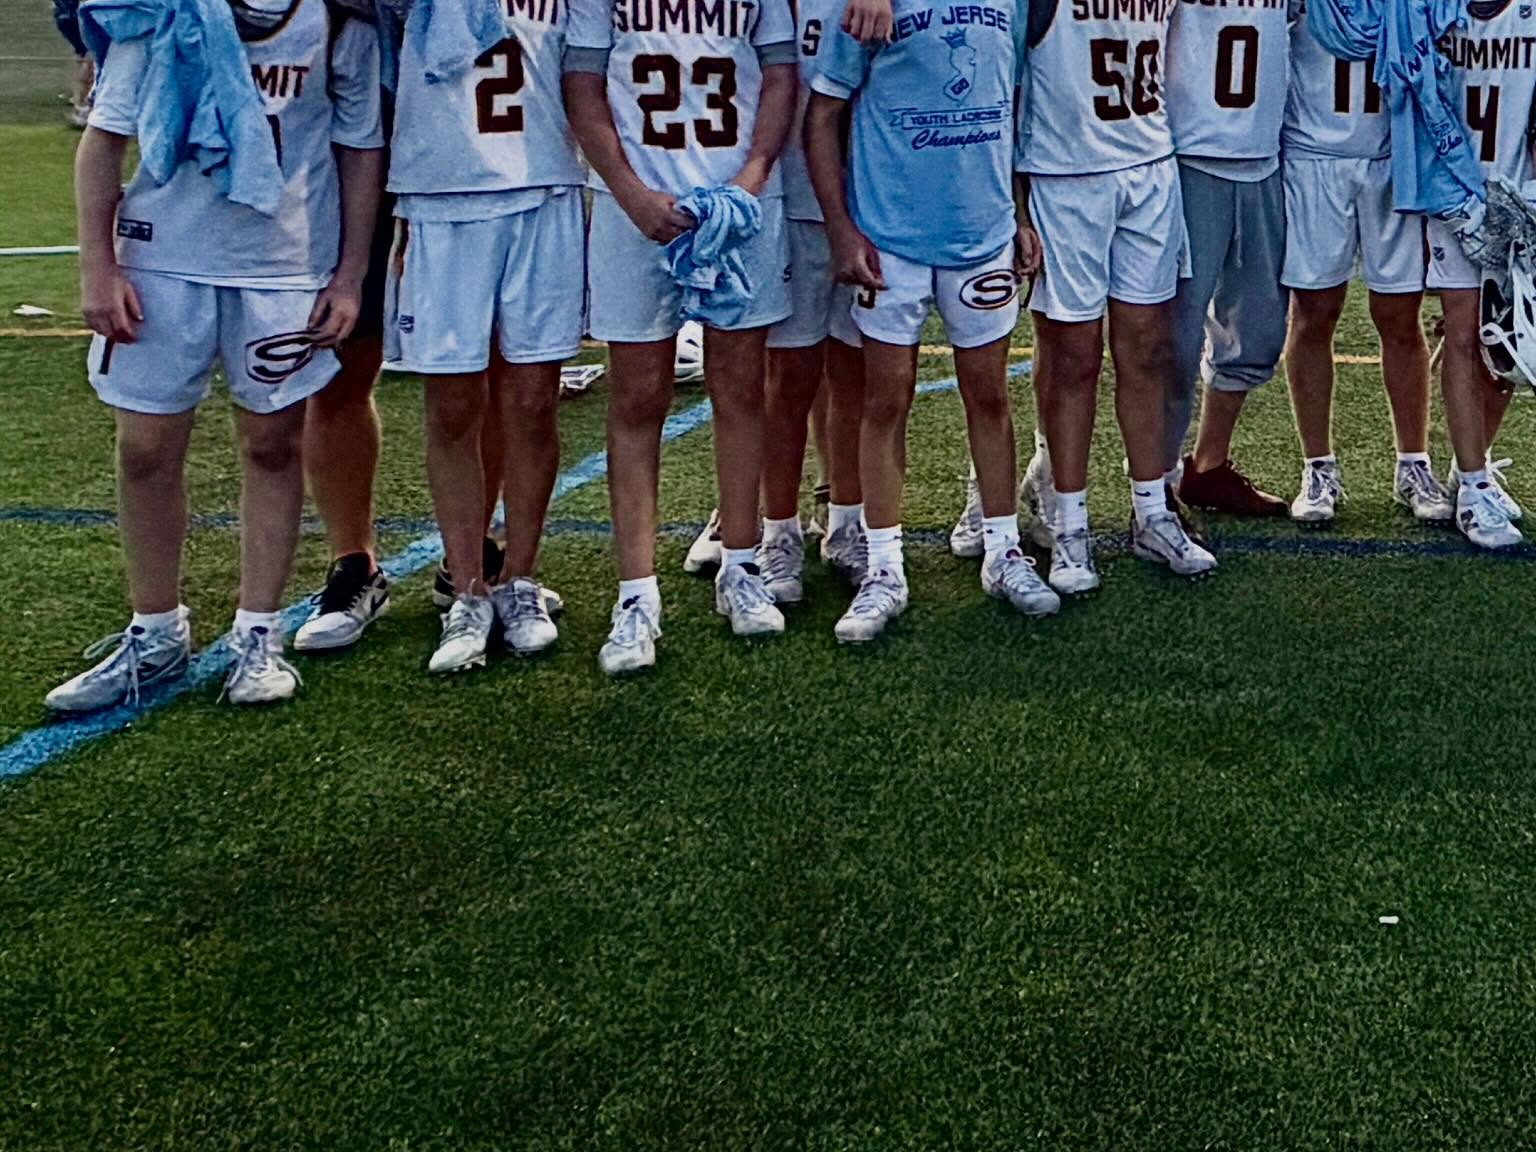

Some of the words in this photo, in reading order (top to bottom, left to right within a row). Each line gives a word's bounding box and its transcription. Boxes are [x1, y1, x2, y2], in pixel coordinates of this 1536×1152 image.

[942, 5, 1010, 32] JERSE
[251, 64, 310, 98] MIT
[473, 37, 525, 135] 2
[1214, 24, 1260, 109] 0
[631, 54, 739, 150] 23
[1465, 85, 1499, 162] 4
[972, 274, 1013, 306] S
[252, 334, 314, 379] S
